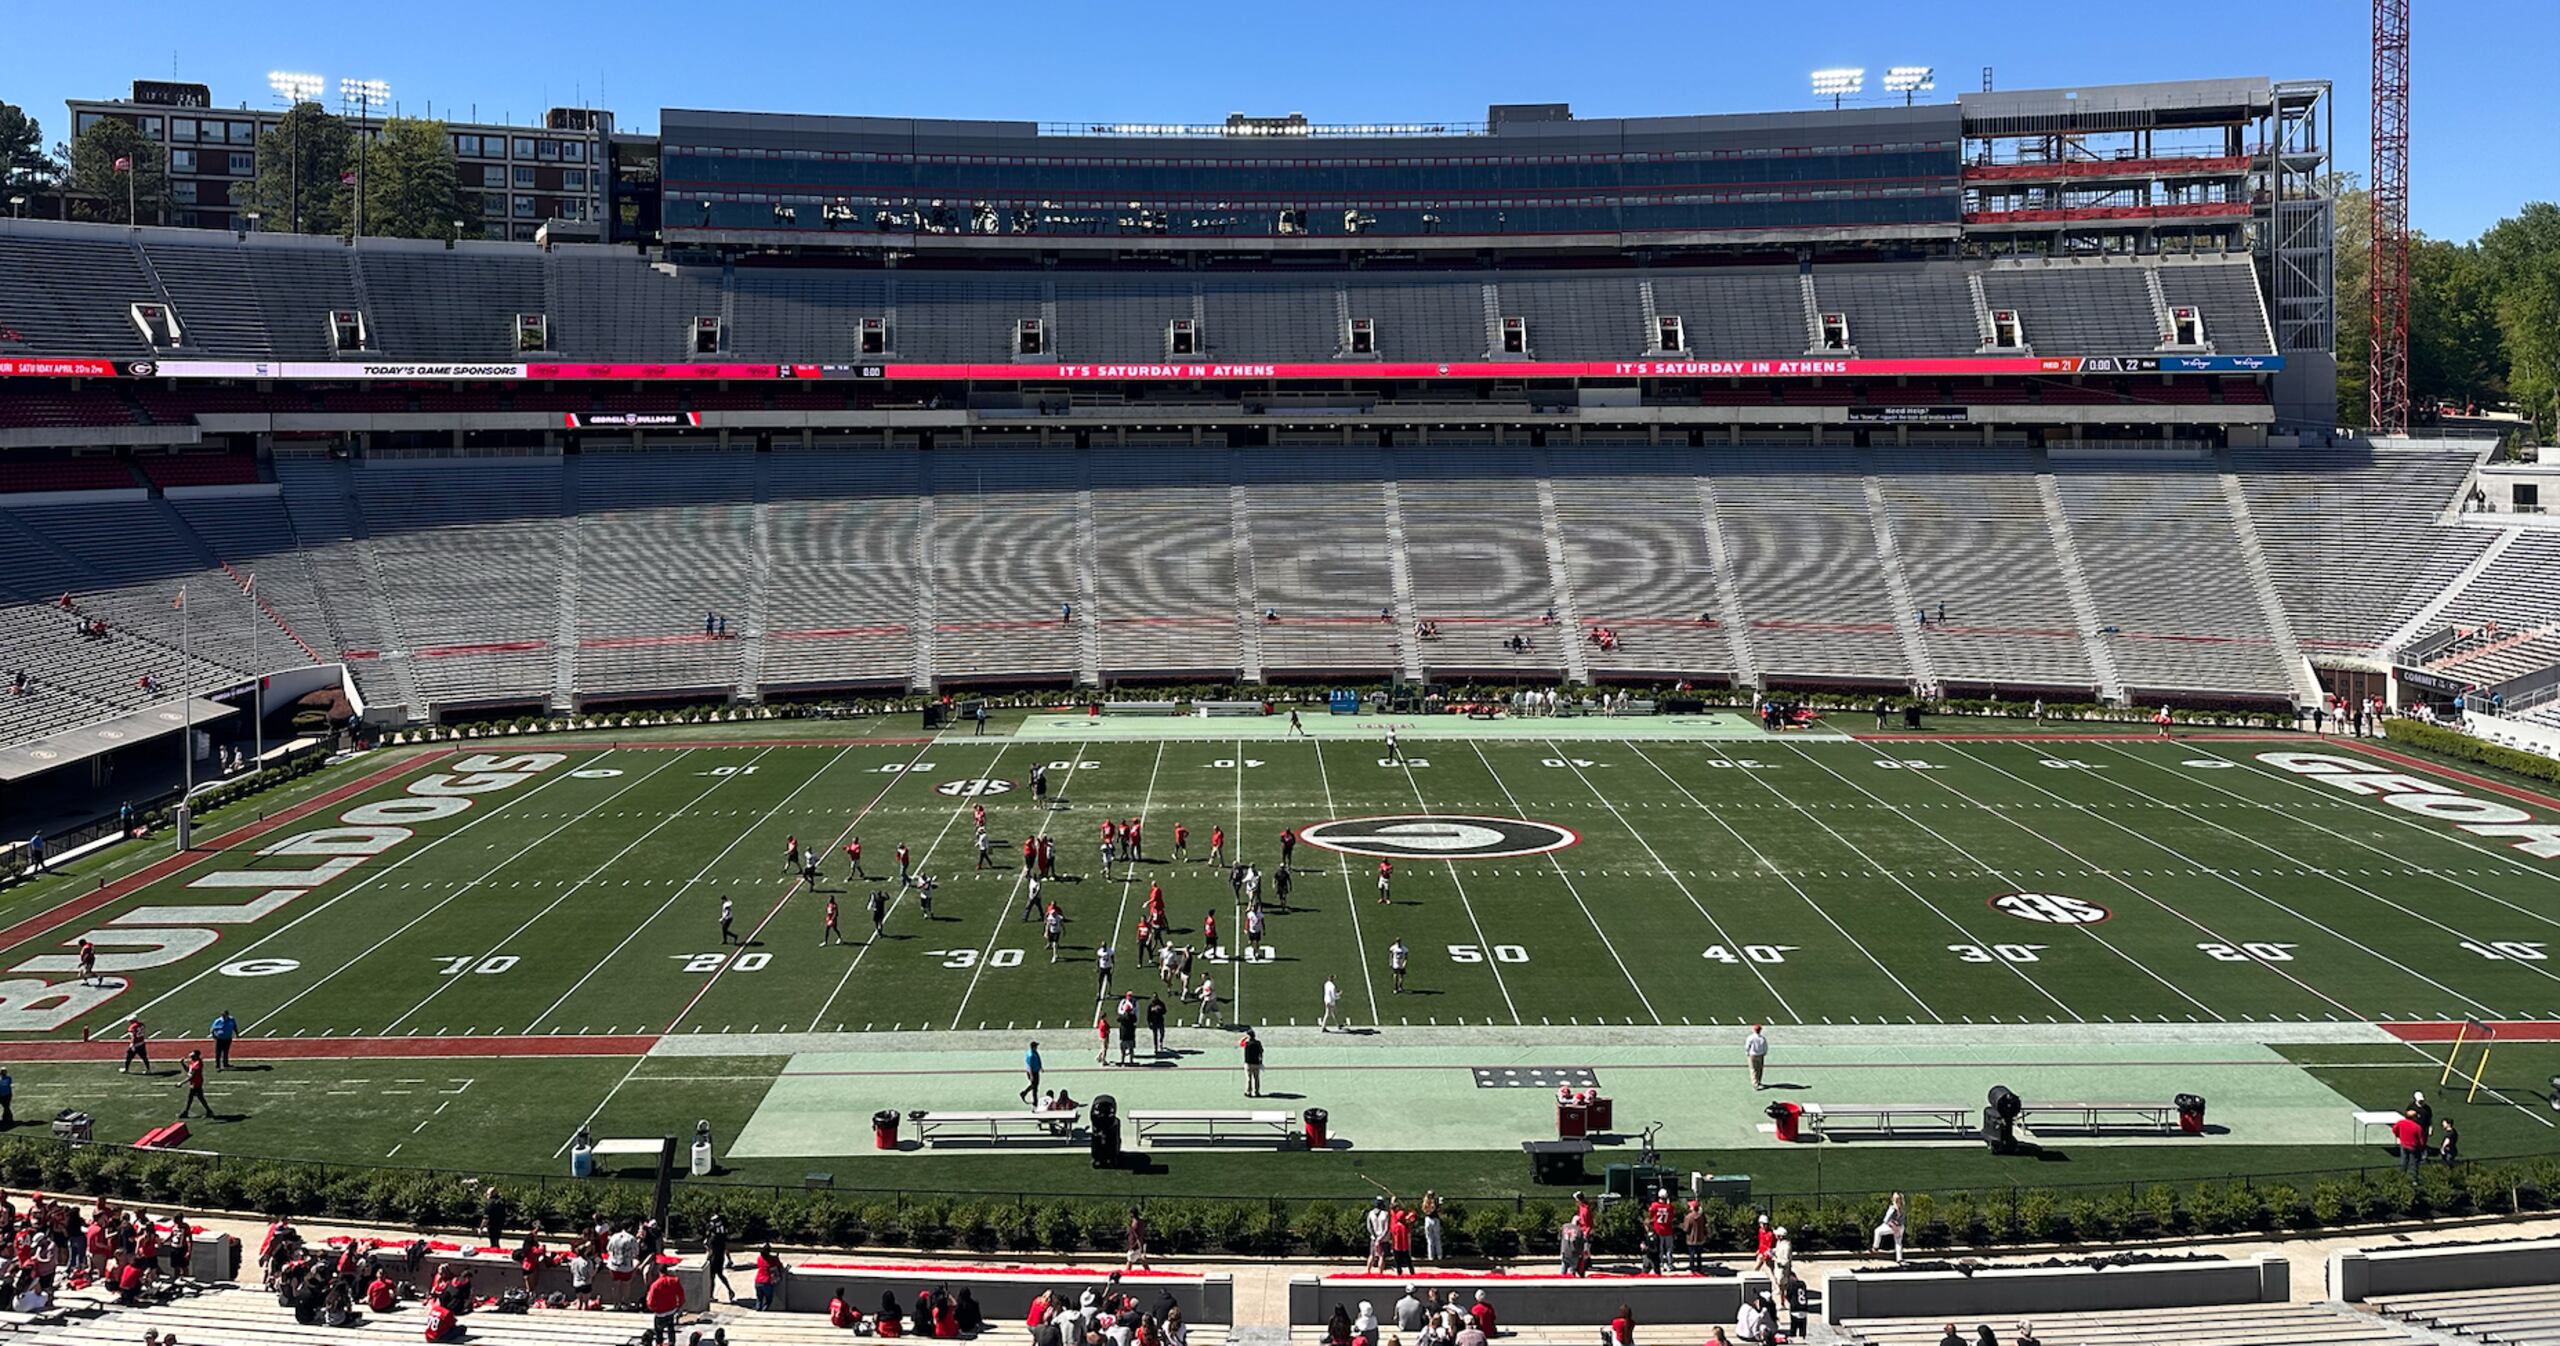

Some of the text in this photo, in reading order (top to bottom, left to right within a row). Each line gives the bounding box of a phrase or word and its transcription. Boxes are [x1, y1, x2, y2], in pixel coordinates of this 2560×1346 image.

[363, 367, 517, 375] TODAY'S GAME SPONSORS
[1060, 365, 1275, 376] IT'S SATURDAY IN ATHENS
[1616, 362, 1847, 373] IT'S SATURDAY IN ATHENS
[2043, 360, 2072, 371] RED 21
[2089, 360, 2111, 371] 0:00
[2126, 360, 2138, 370] 22
[2404, 672, 2437, 688] COMMIT
[0, 752, 568, 1031] BULLDOGS
[943, 949, 1026, 969] 30
[1447, 945, 1530, 963] 50
[1702, 945, 1785, 964] 40
[1947, 944, 2041, 963] 30
[2196, 943, 2295, 962] 20
[2459, 941, 2549, 960] 10
[439, 956, 521, 975] 10
[683, 953, 774, 972] 20
[1657, 1211, 1669, 1224] 27
[1797, 1287, 1806, 1305] 8
